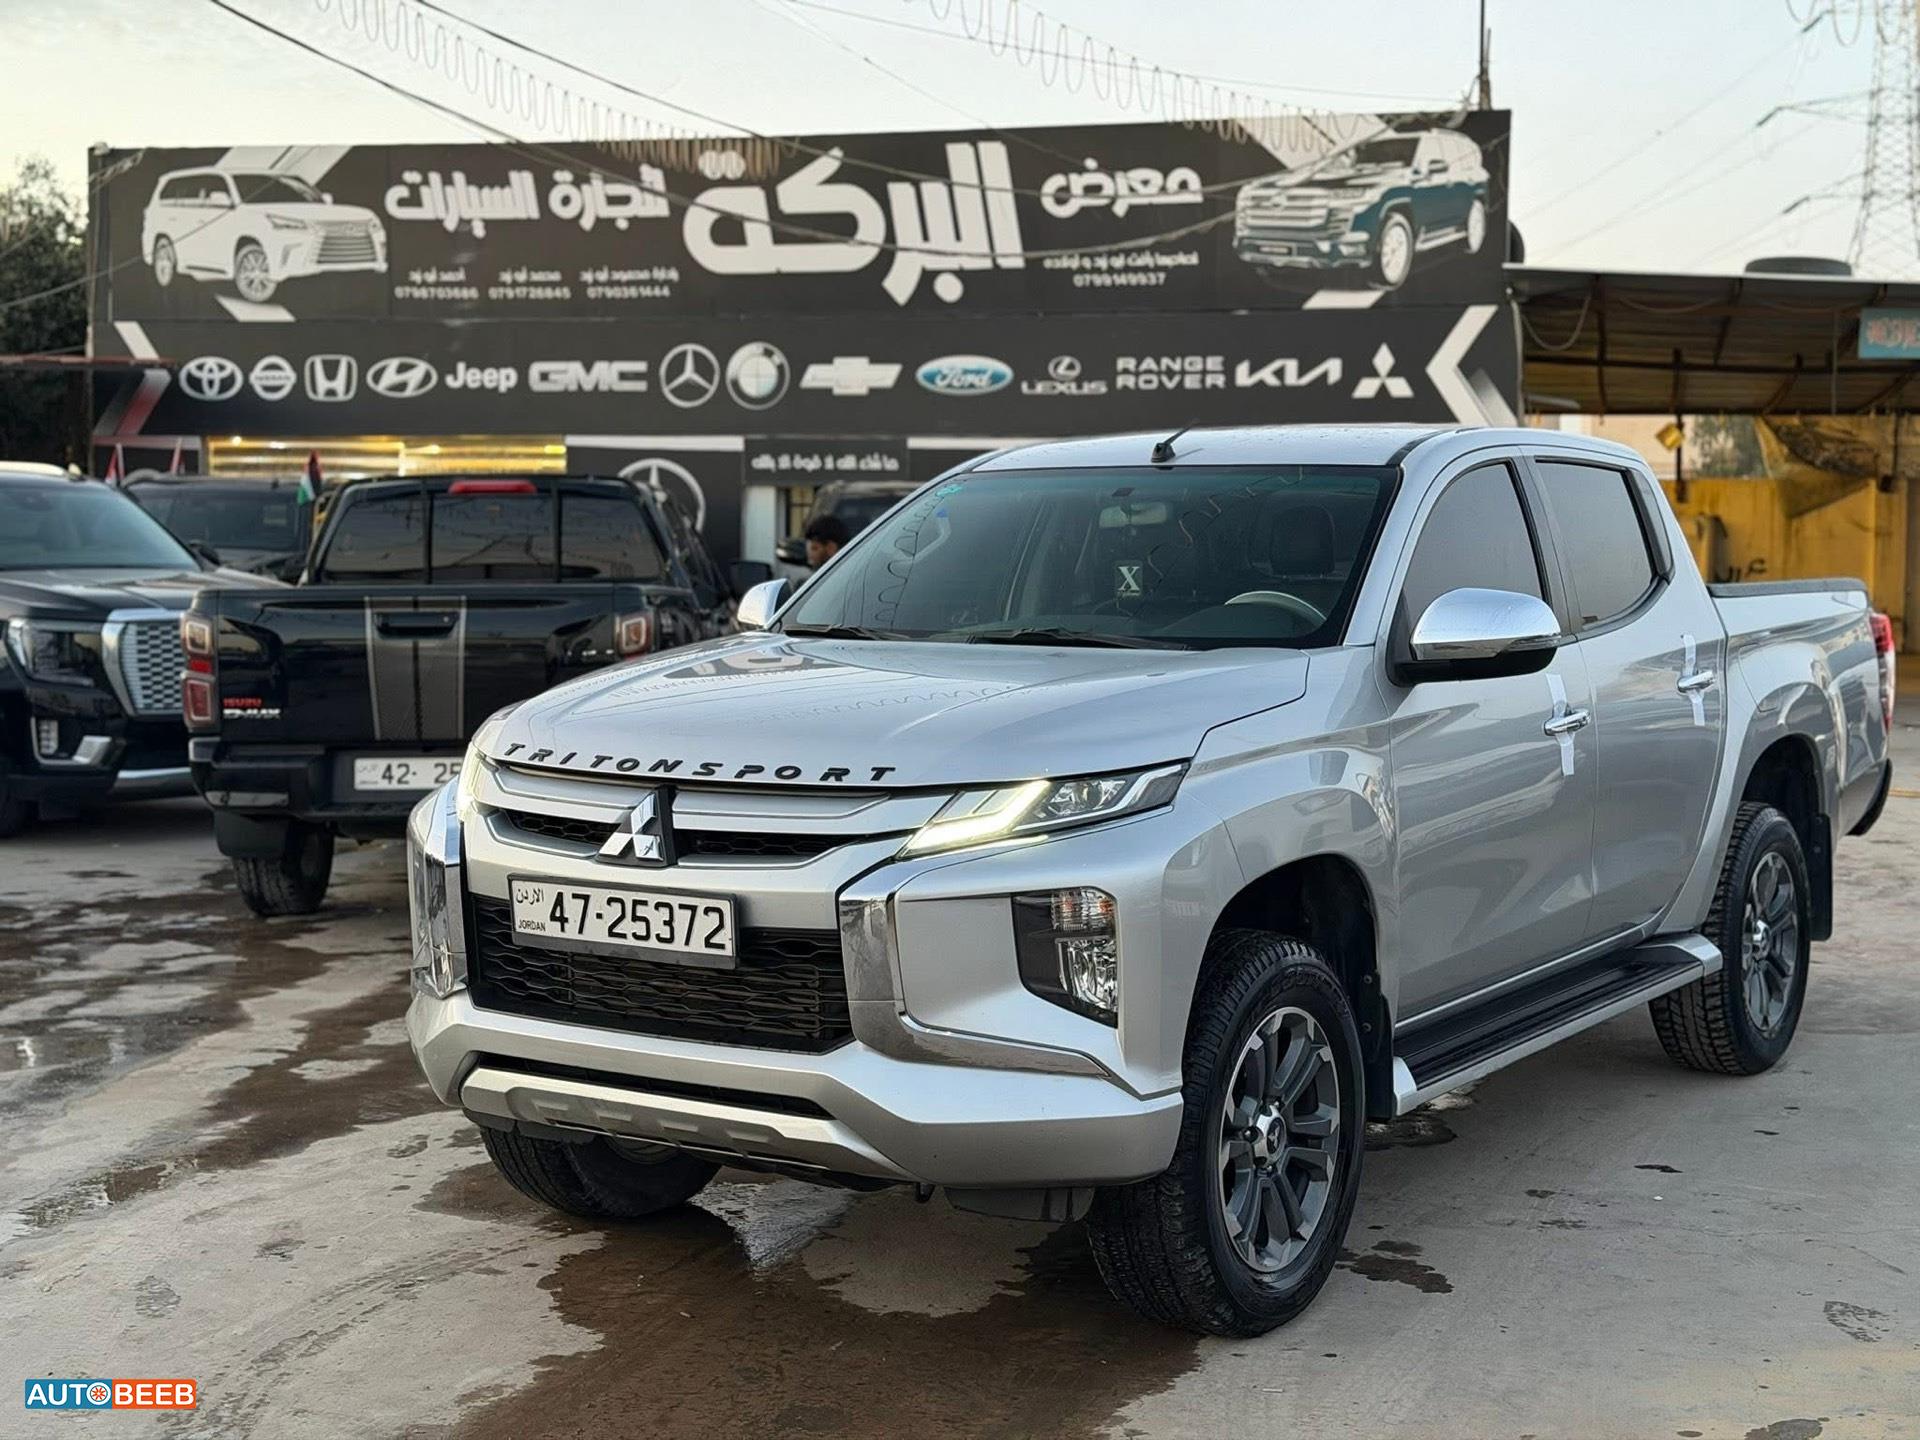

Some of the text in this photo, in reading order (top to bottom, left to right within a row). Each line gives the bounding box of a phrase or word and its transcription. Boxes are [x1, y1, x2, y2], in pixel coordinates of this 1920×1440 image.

[385, 140, 1203, 307] معرض البركة لتجارة السيارات
[528, 360, 648, 392] GMC
[934, 364, 992, 389] Ford
[1116, 356, 1224, 373] RANGE
[445, 361, 518, 393] Jeep
[1021, 379, 1108, 395] LEXUS
[1116, 373, 1226, 390] ROVER
[1117, 566, 1140, 590] X
[518, 918, 546, 932] JORDAN
[549, 891, 726, 949] 47-25372
